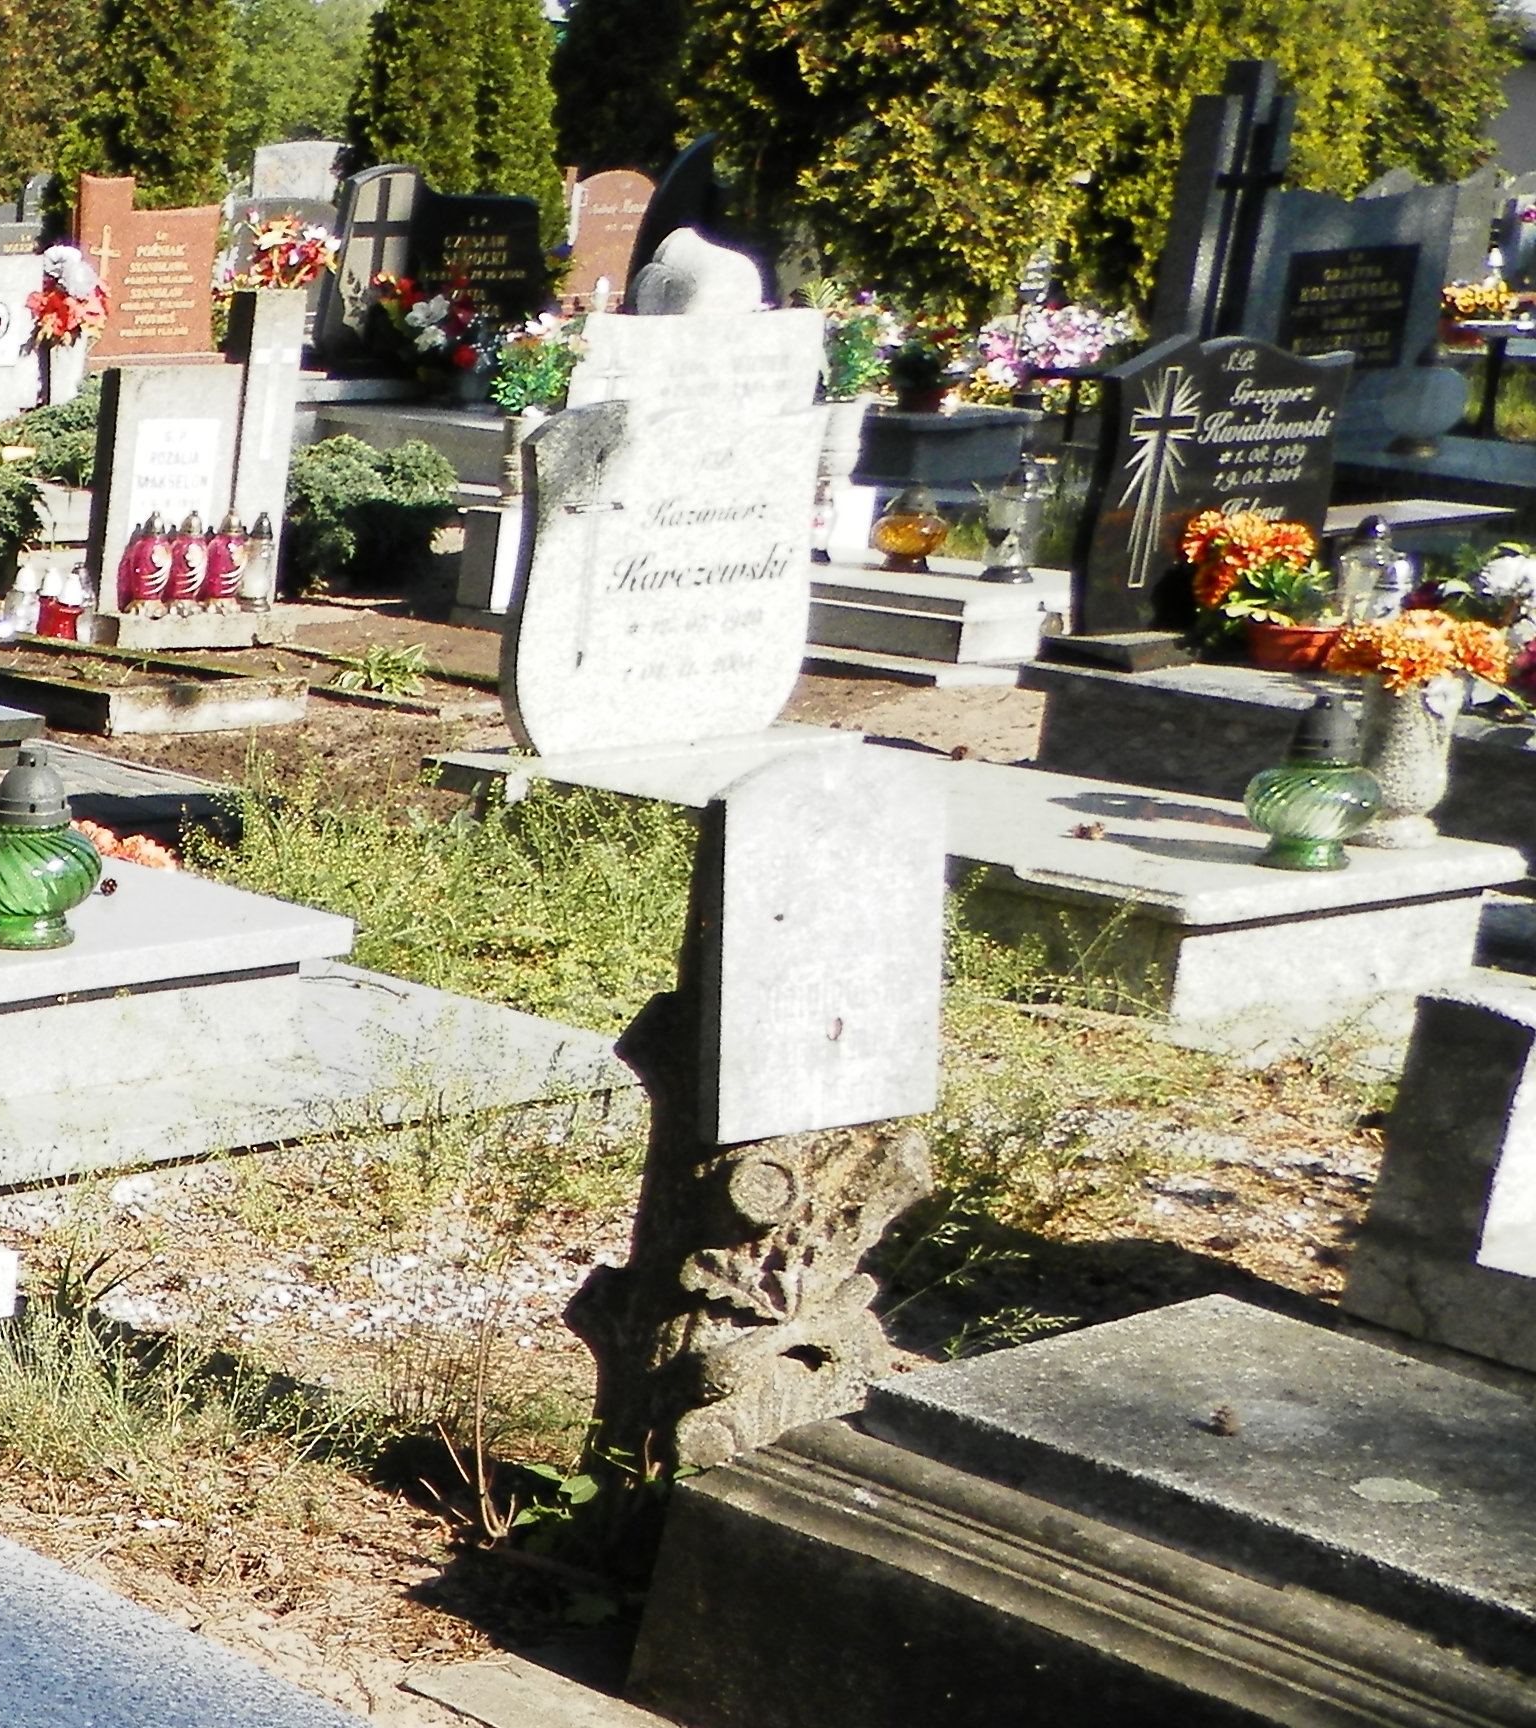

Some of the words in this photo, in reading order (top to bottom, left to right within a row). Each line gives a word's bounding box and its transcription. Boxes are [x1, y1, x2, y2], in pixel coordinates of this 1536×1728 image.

[1229, 378, 1317, 414] Grzegorz
[1197, 406, 1335, 444] Kwiatkowski
[605, 541, 794, 594] Karczewski
